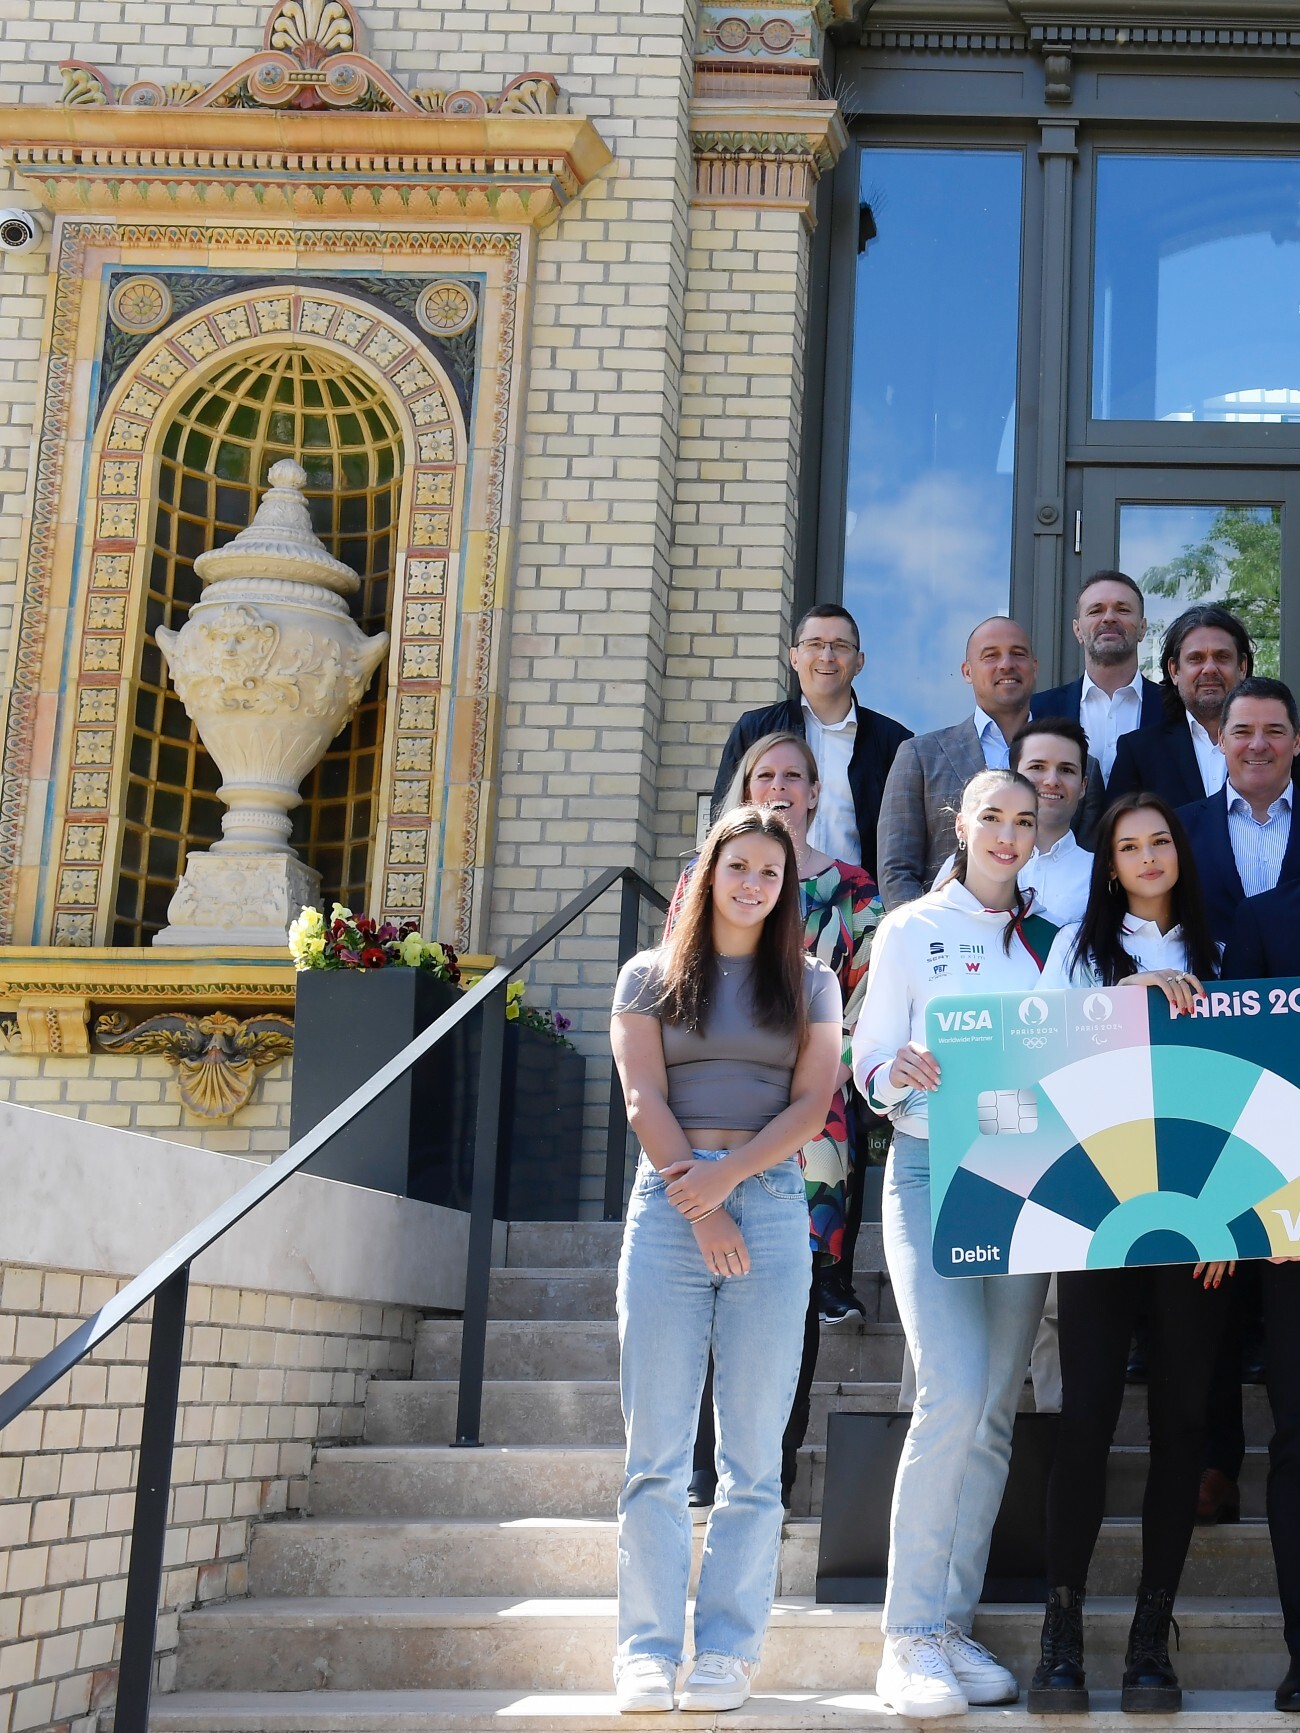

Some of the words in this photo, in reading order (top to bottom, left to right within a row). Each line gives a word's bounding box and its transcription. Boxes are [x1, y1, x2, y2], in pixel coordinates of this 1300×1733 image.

[932, 1009, 993, 1032] VISA
[1036, 1027, 1058, 1035] 2024
[1101, 1023, 1123, 1031] 2024
[938, 1036, 971, 1044] Worldwide
[951, 1244, 1001, 1264] Debit
